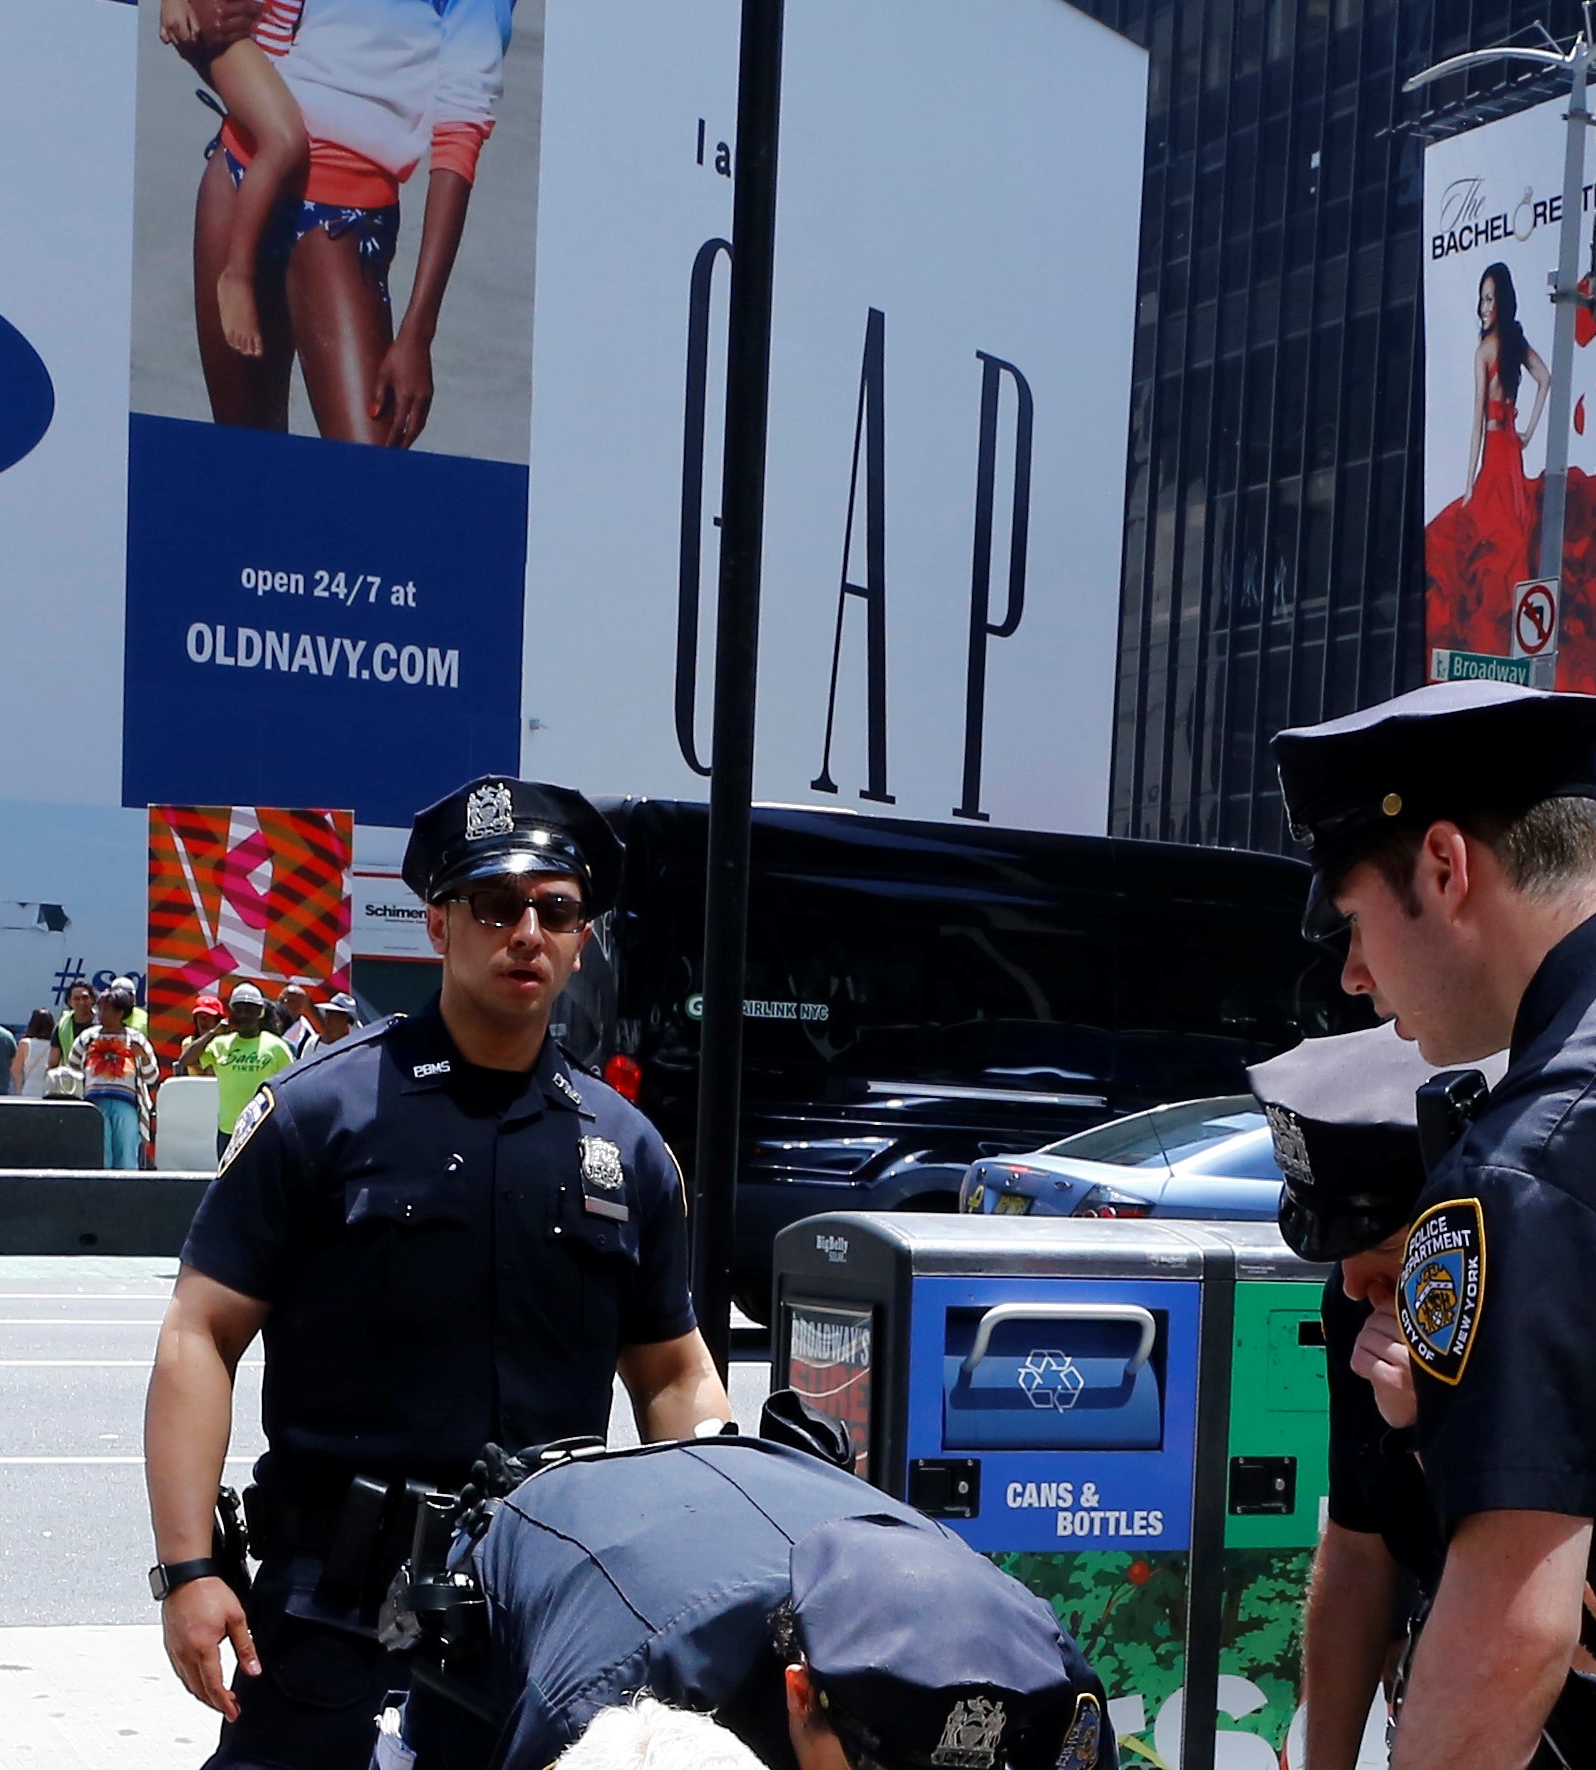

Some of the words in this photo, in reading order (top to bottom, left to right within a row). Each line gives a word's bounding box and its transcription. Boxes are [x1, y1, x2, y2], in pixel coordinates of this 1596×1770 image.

[1432, 184, 1596, 261] BACHELORET
[1440, 174, 1486, 233] The
[240, 566, 305, 596] open
[313, 568, 383, 607] 24/7
[390, 579, 417, 608] at
[186, 621, 460, 689] OLDNAVY.COM
[1452, 656, 1527, 686] Broadway
[800, 1003, 829, 1021] NYC
[222, 1048, 273, 1070] Safety
[1409, 1215, 1448, 1255] POLICE
[1400, 1229, 1472, 1290] DEPARTMENT
[1401, 1308, 1420, 1343] CITY
[1418, 1342, 1437, 1362] OF
[1452, 1313, 1474, 1357] NEW
[1464, 1255, 1480, 1312] YORK
[791, 1312, 871, 1367] BROADWAY'S
[1006, 1481, 1074, 1509] CANS
[1079, 1481, 1100, 1508] &
[1056, 1509, 1164, 1538] BOTTLES
